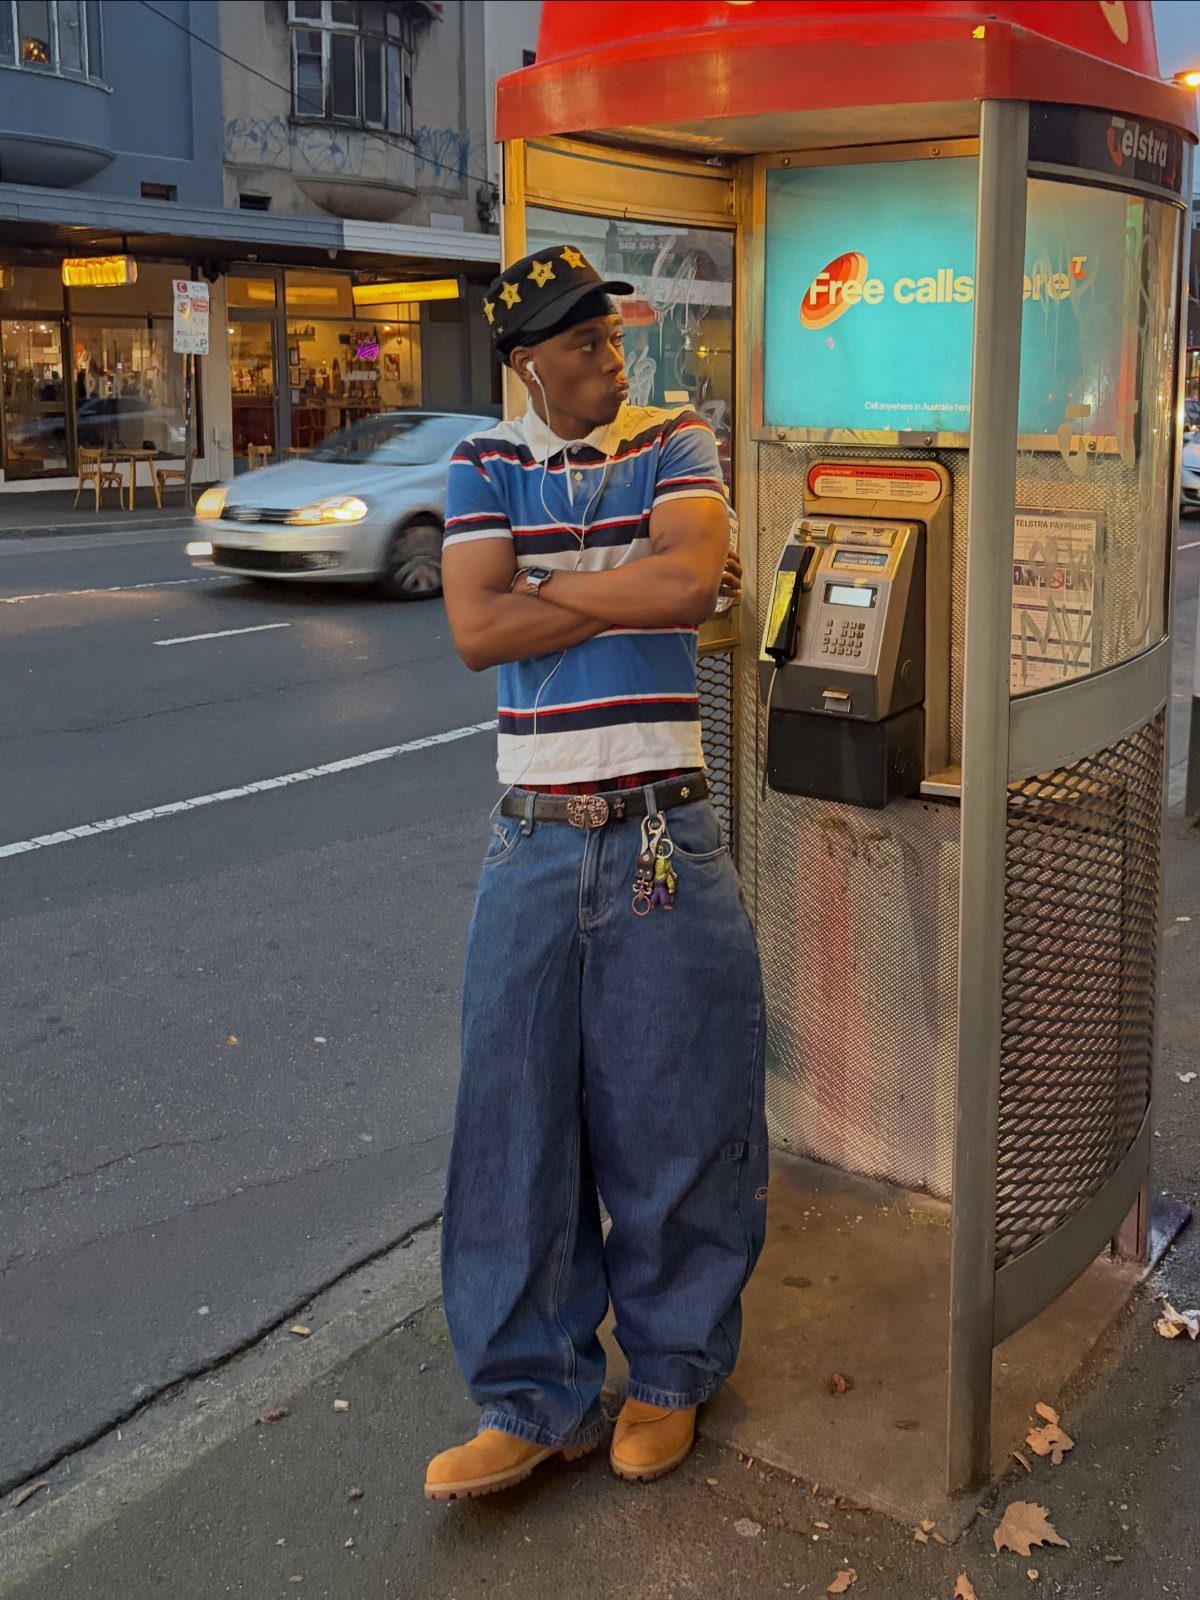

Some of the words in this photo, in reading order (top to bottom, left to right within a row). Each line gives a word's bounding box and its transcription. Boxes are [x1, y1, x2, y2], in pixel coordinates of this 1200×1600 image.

[1106, 116, 1168, 167] Telstra
[809, 272, 885, 306] Free
[893, 268, 974, 304] calls
[1022, 272, 1071, 301] ere
[864, 401, 878, 410] Call
[879, 402, 914, 411] anywhere
[922, 402, 954, 411] Australia
[1015, 519, 1048, 529] TELSTRA
[1049, 521, 1093, 531] PAYPHONE
[1014, 570, 1020, 582] 1
